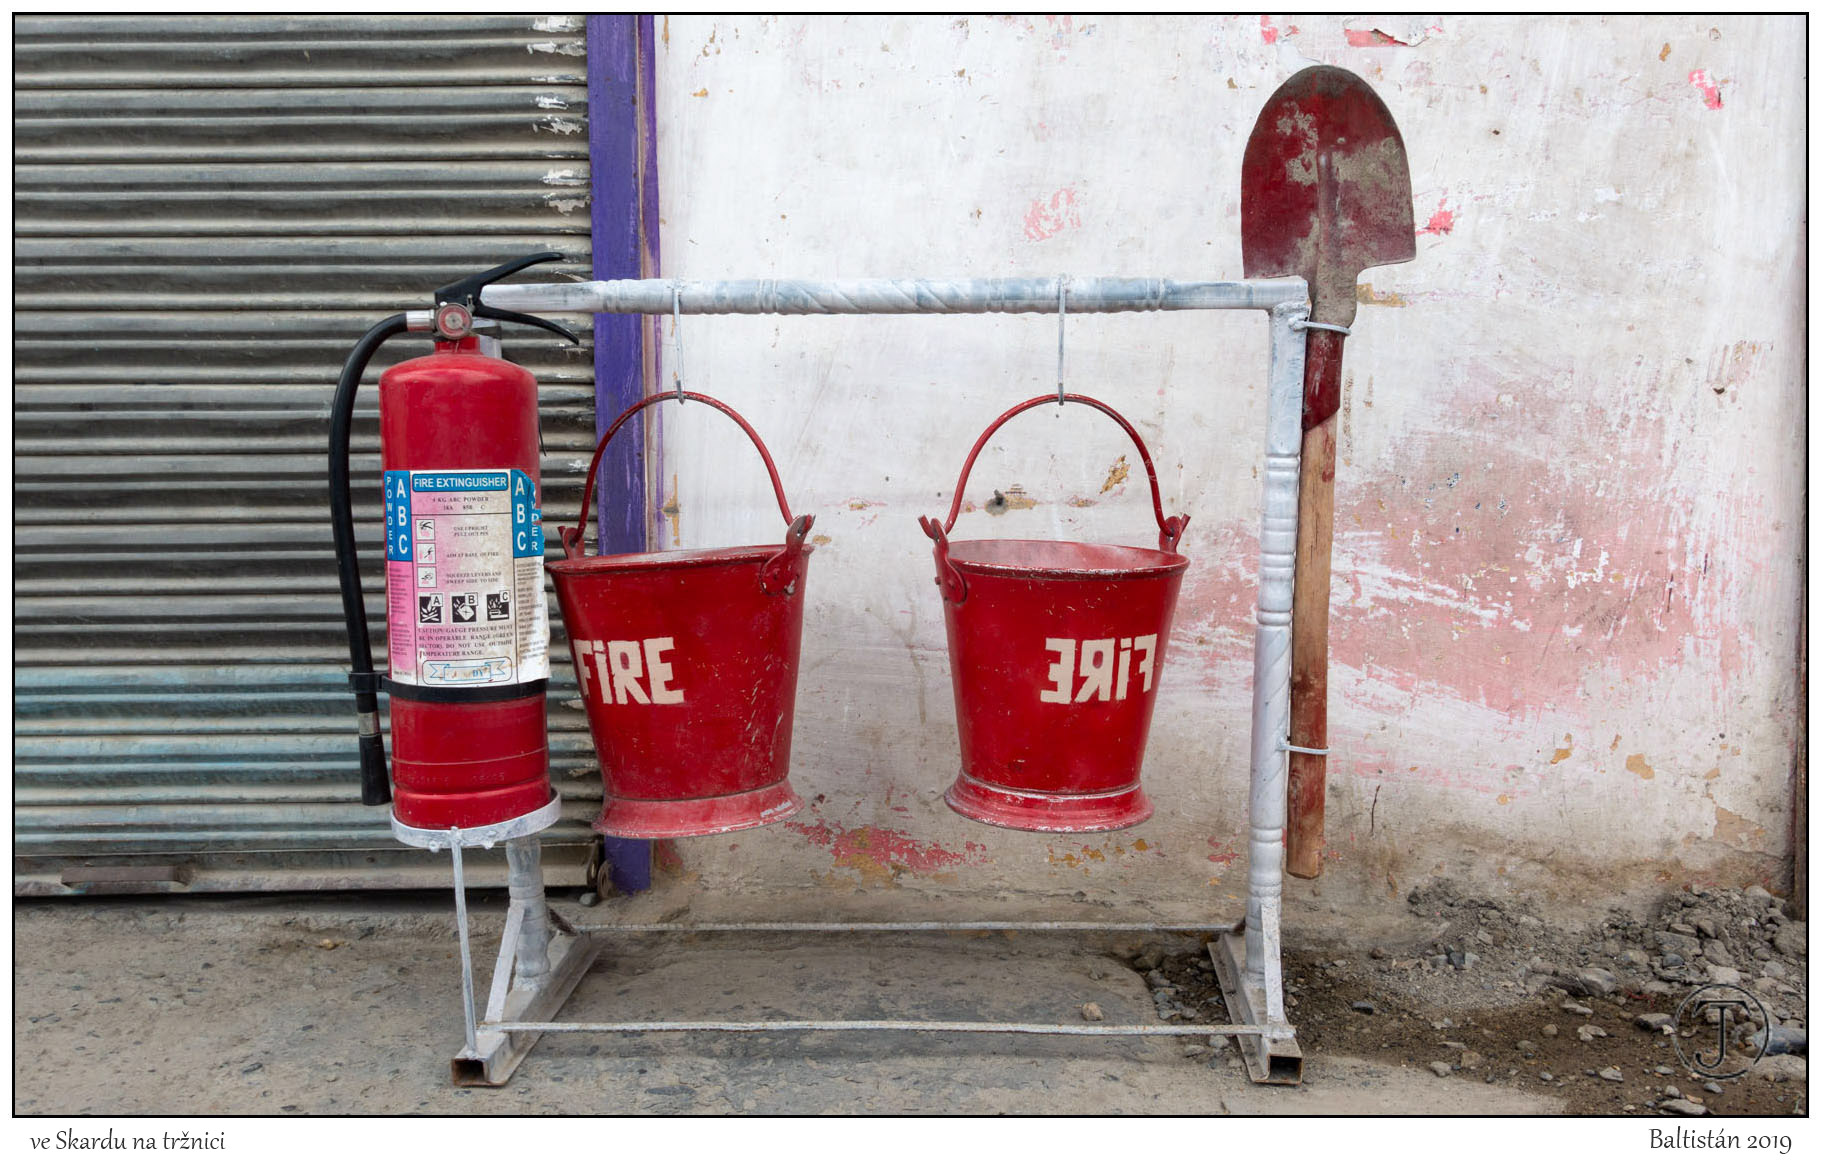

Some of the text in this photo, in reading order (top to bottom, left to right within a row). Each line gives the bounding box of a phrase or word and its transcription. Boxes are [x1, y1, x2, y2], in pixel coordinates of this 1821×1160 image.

[414, 477, 507, 488] FIRE EXTINGUISHER
[386, 476, 394, 555] POWDER
[433, 595, 440, 605] A
[468, 594, 475, 604] B
[502, 591, 509, 601] C
[468, 624, 498, 632] PRESSURE
